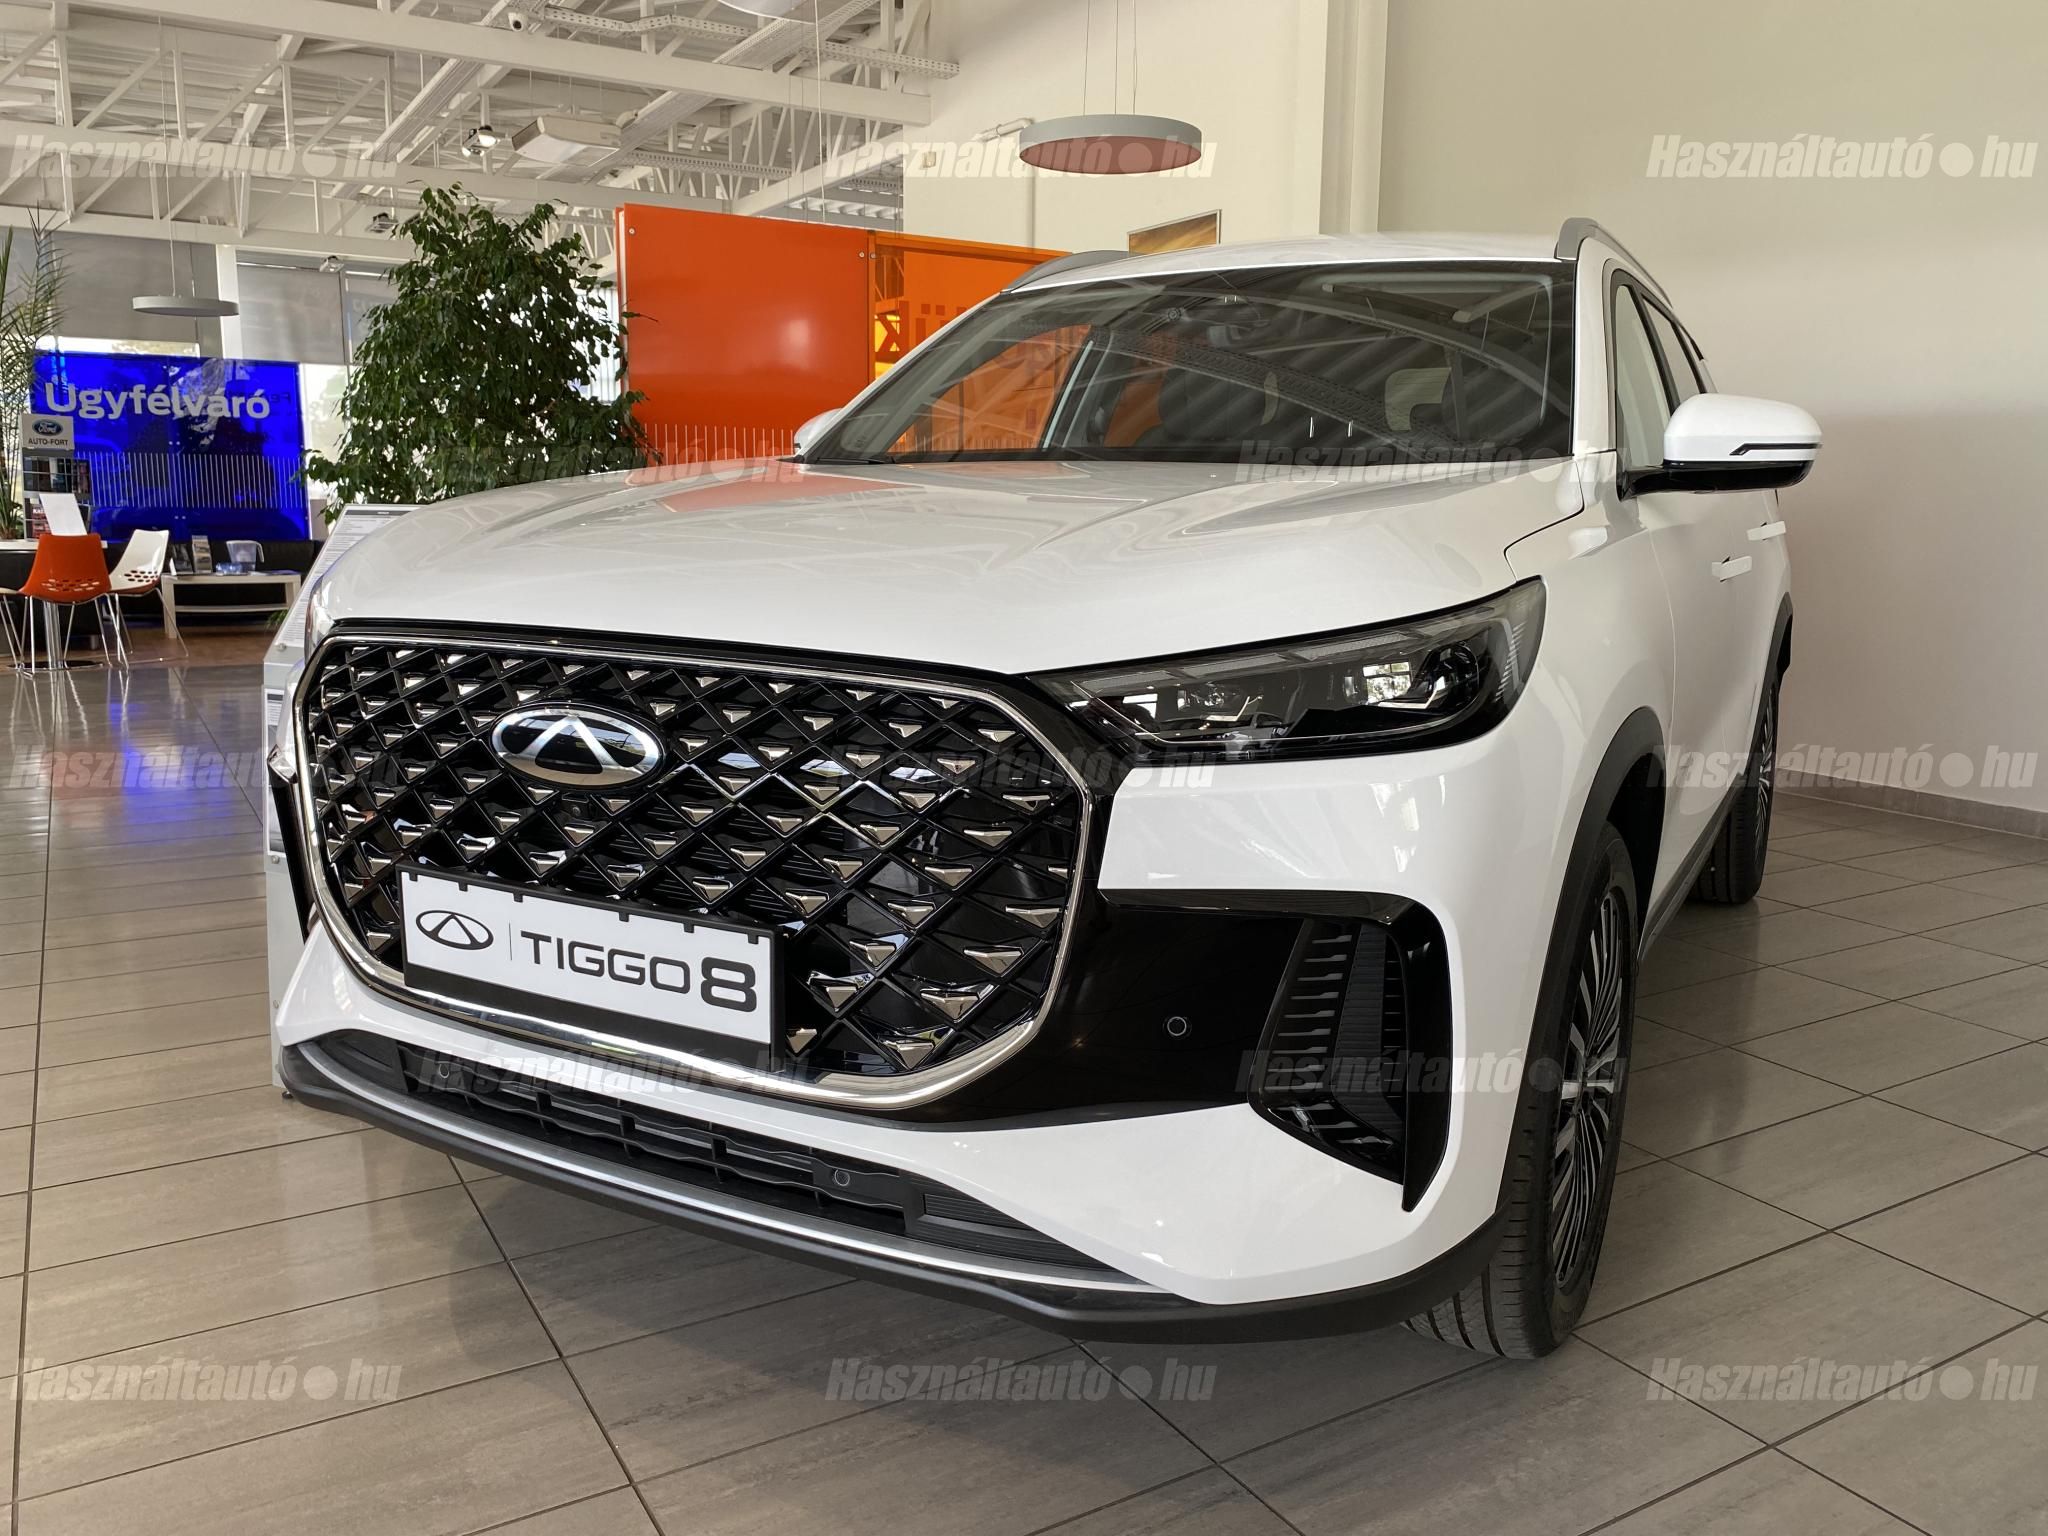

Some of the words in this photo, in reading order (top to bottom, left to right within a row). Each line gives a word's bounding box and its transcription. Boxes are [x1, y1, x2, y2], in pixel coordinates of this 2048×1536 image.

[28, 437, 69, 447] AUTO-FORT
[520, 930, 691, 995] TIGGO
[700, 957, 757, 1013] 8
